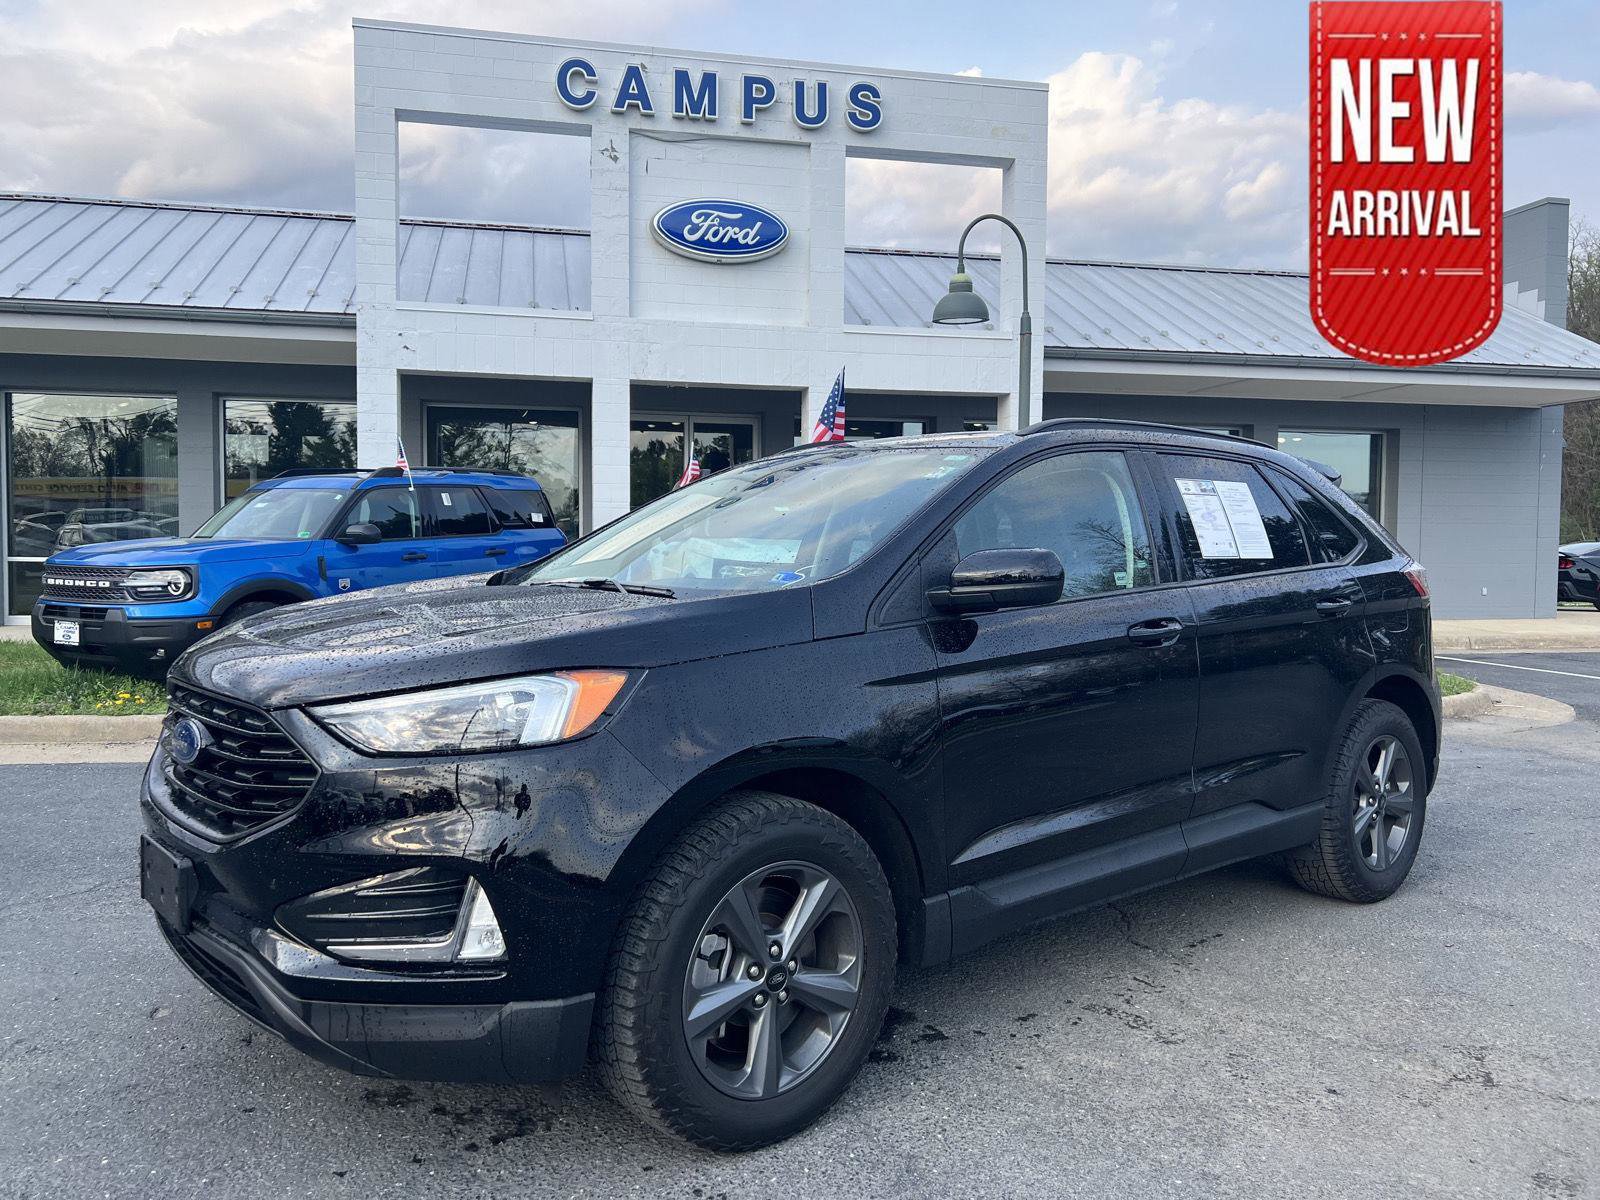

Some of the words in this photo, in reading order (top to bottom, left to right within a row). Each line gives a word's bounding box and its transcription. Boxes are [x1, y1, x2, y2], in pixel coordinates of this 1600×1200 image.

[555, 56, 884, 133] CAMPUS
[683, 209, 763, 245] Ford
[47, 578, 110, 588] BRONCO
